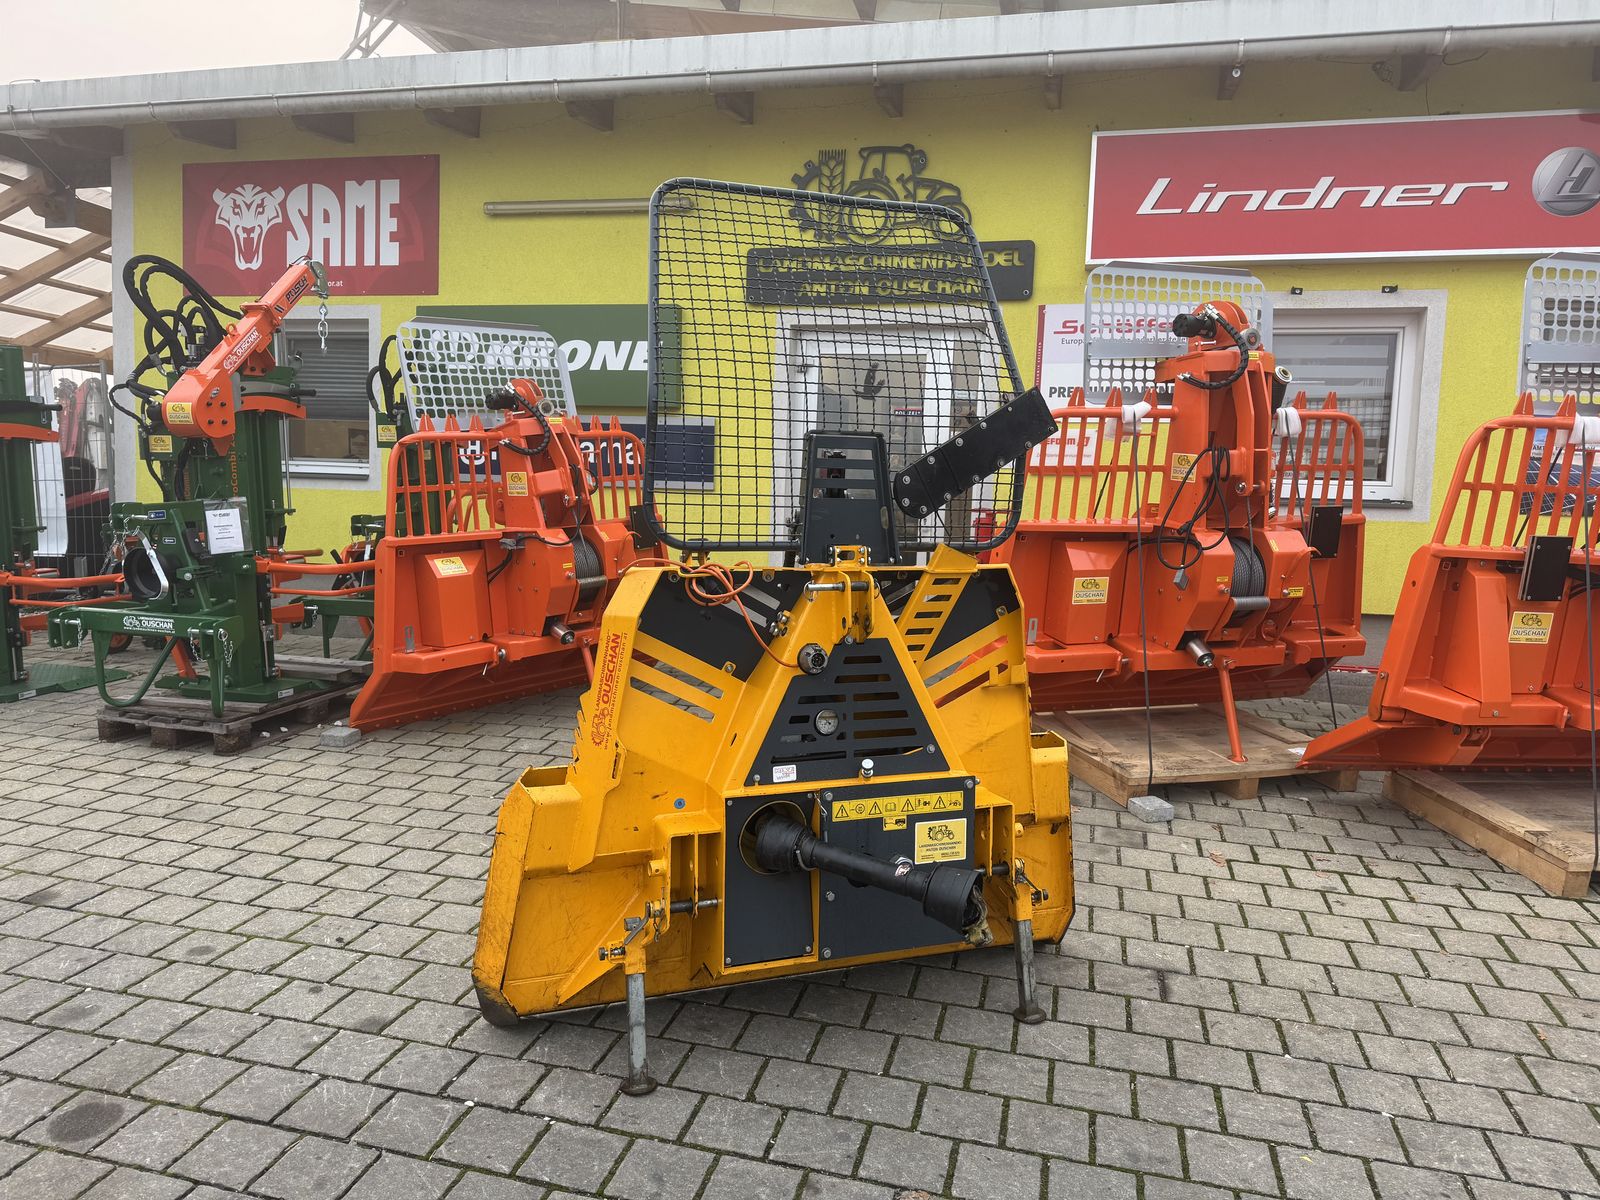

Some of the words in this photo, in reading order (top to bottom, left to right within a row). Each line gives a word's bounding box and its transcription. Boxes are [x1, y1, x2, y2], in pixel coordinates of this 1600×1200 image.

[1136, 177, 1509, 215] Lindner
[286, 179, 400, 267] SAME
[236, 330, 260, 357] OUSCHAN
[141, 619, 173, 629] OUSCHAN
[1512, 629, 1547, 637] OUSCHAN
[602, 632, 621, 705] OUSCHAN
